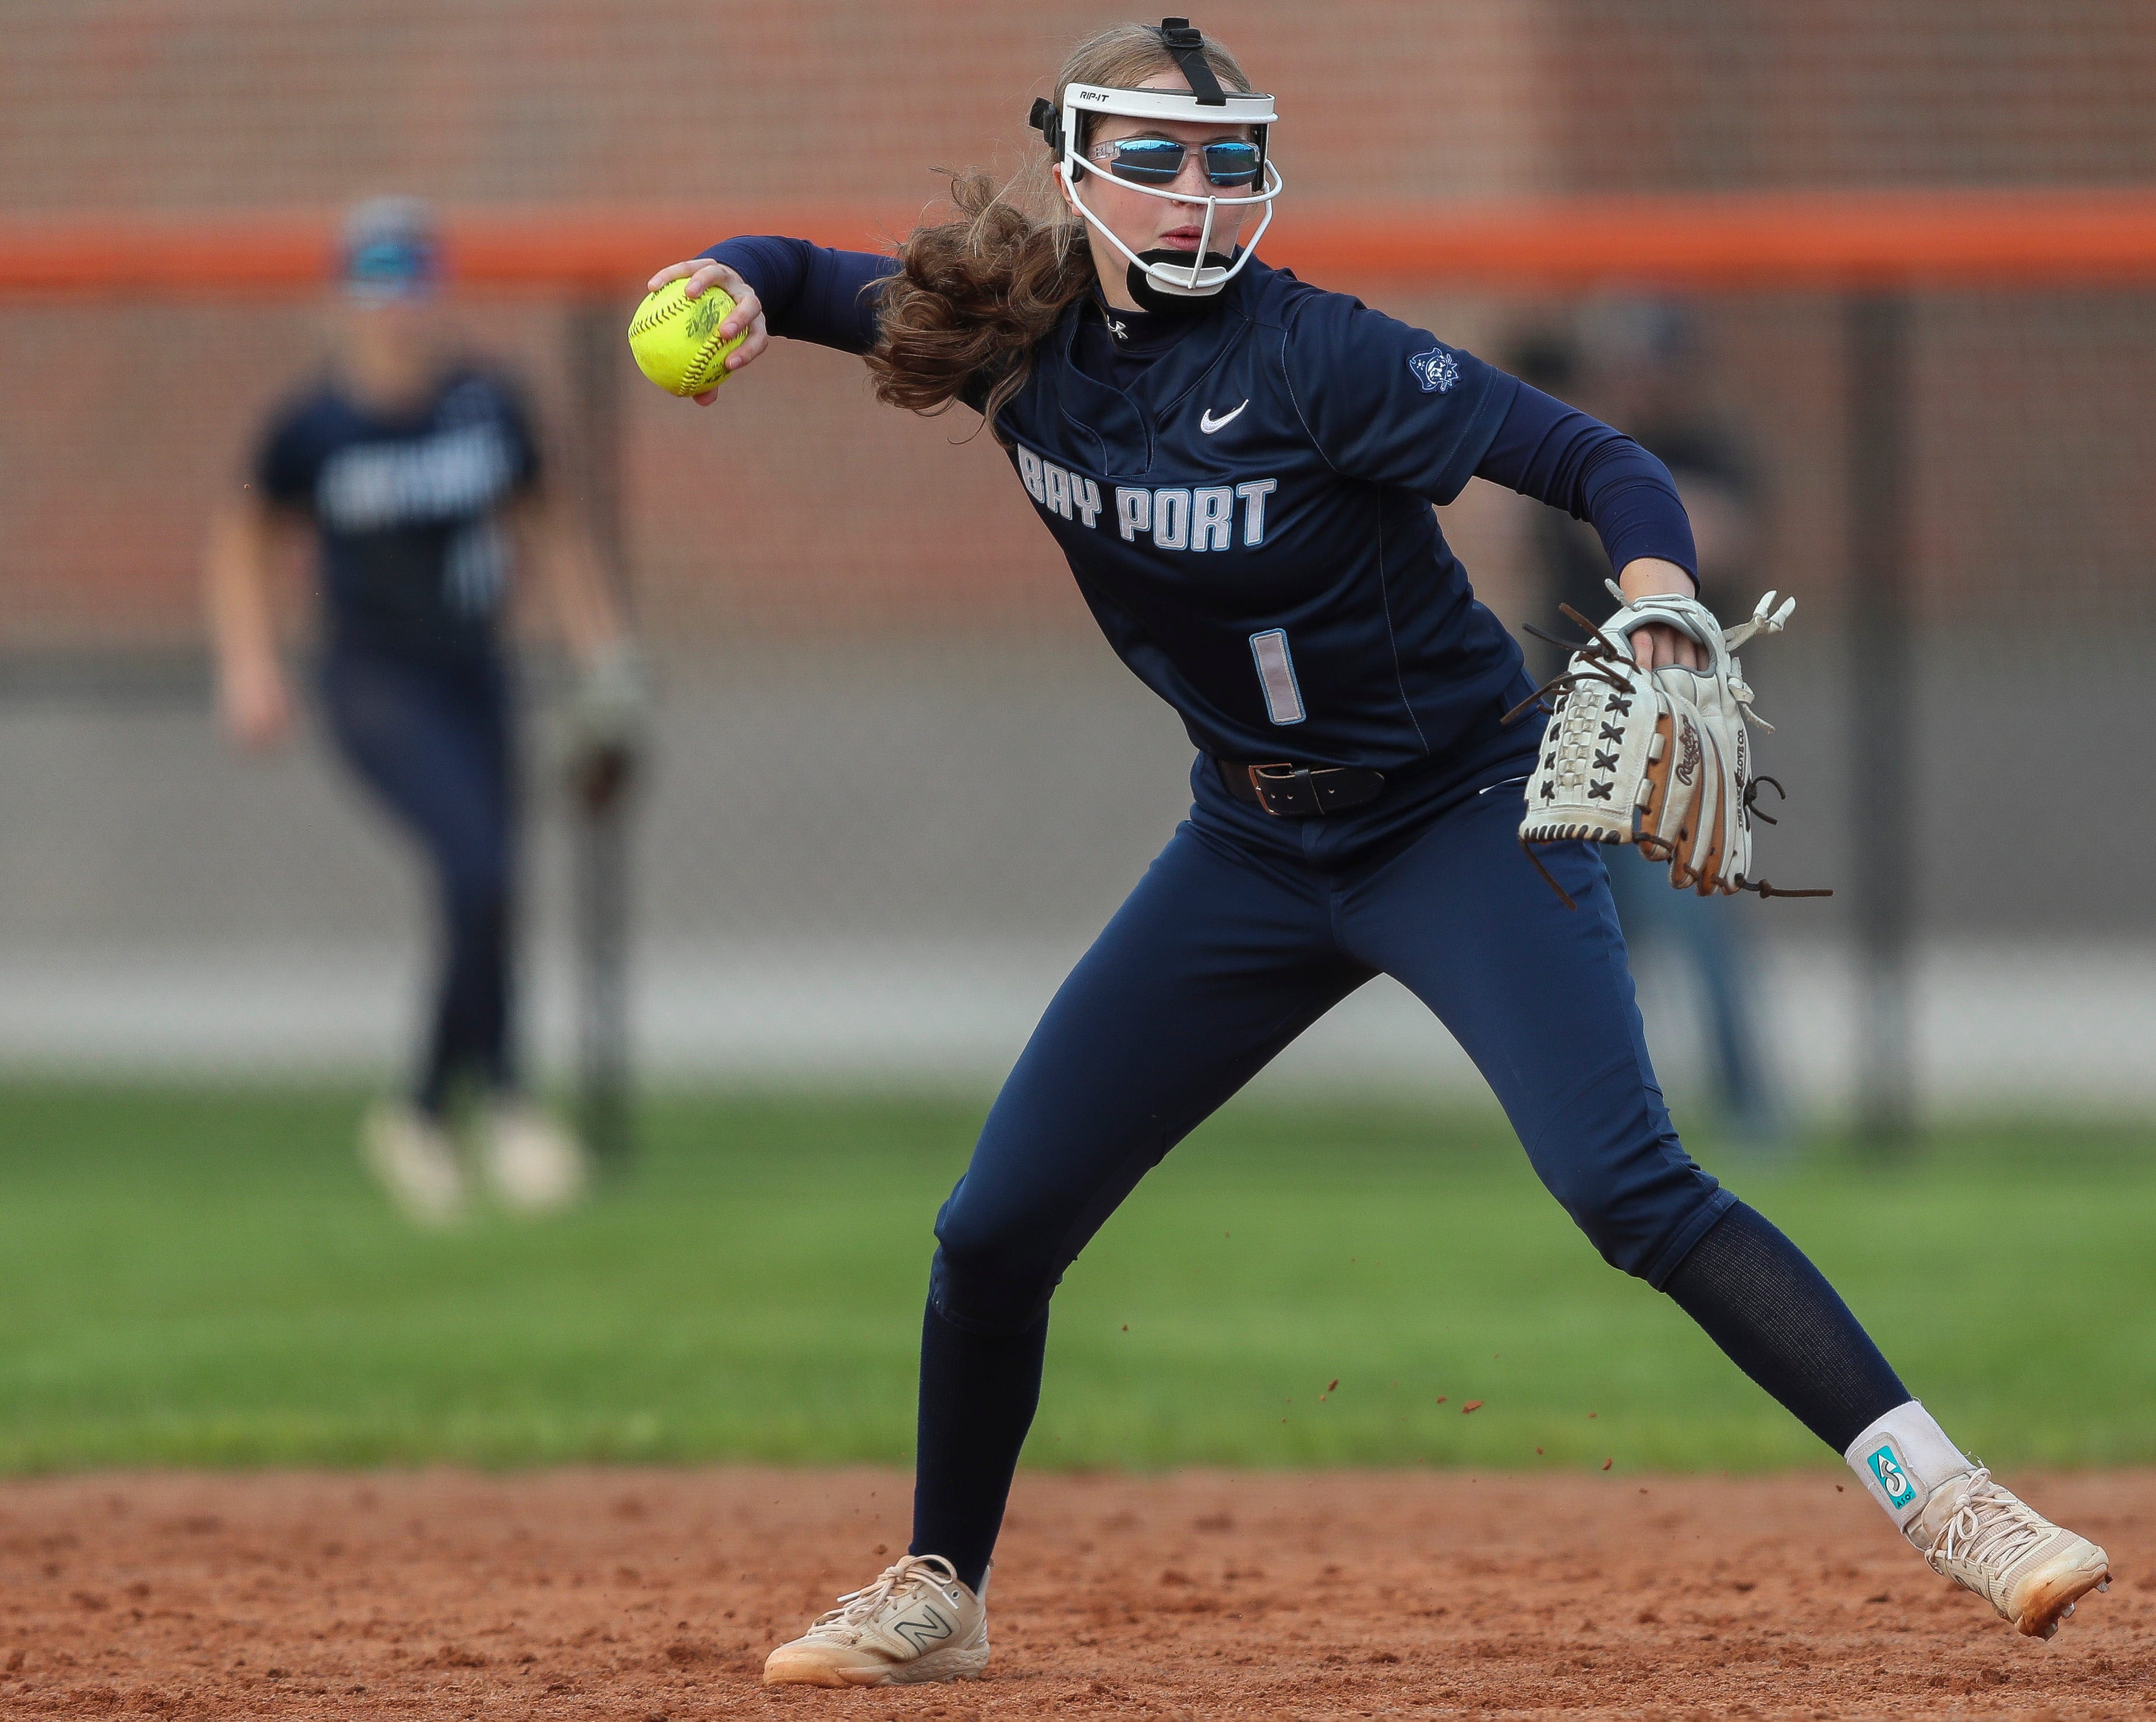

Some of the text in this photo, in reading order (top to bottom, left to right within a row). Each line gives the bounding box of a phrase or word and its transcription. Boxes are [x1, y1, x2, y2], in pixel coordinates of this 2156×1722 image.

[1017, 443, 1277, 552] BAY PORT
[1249, 628, 1307, 726] 1
